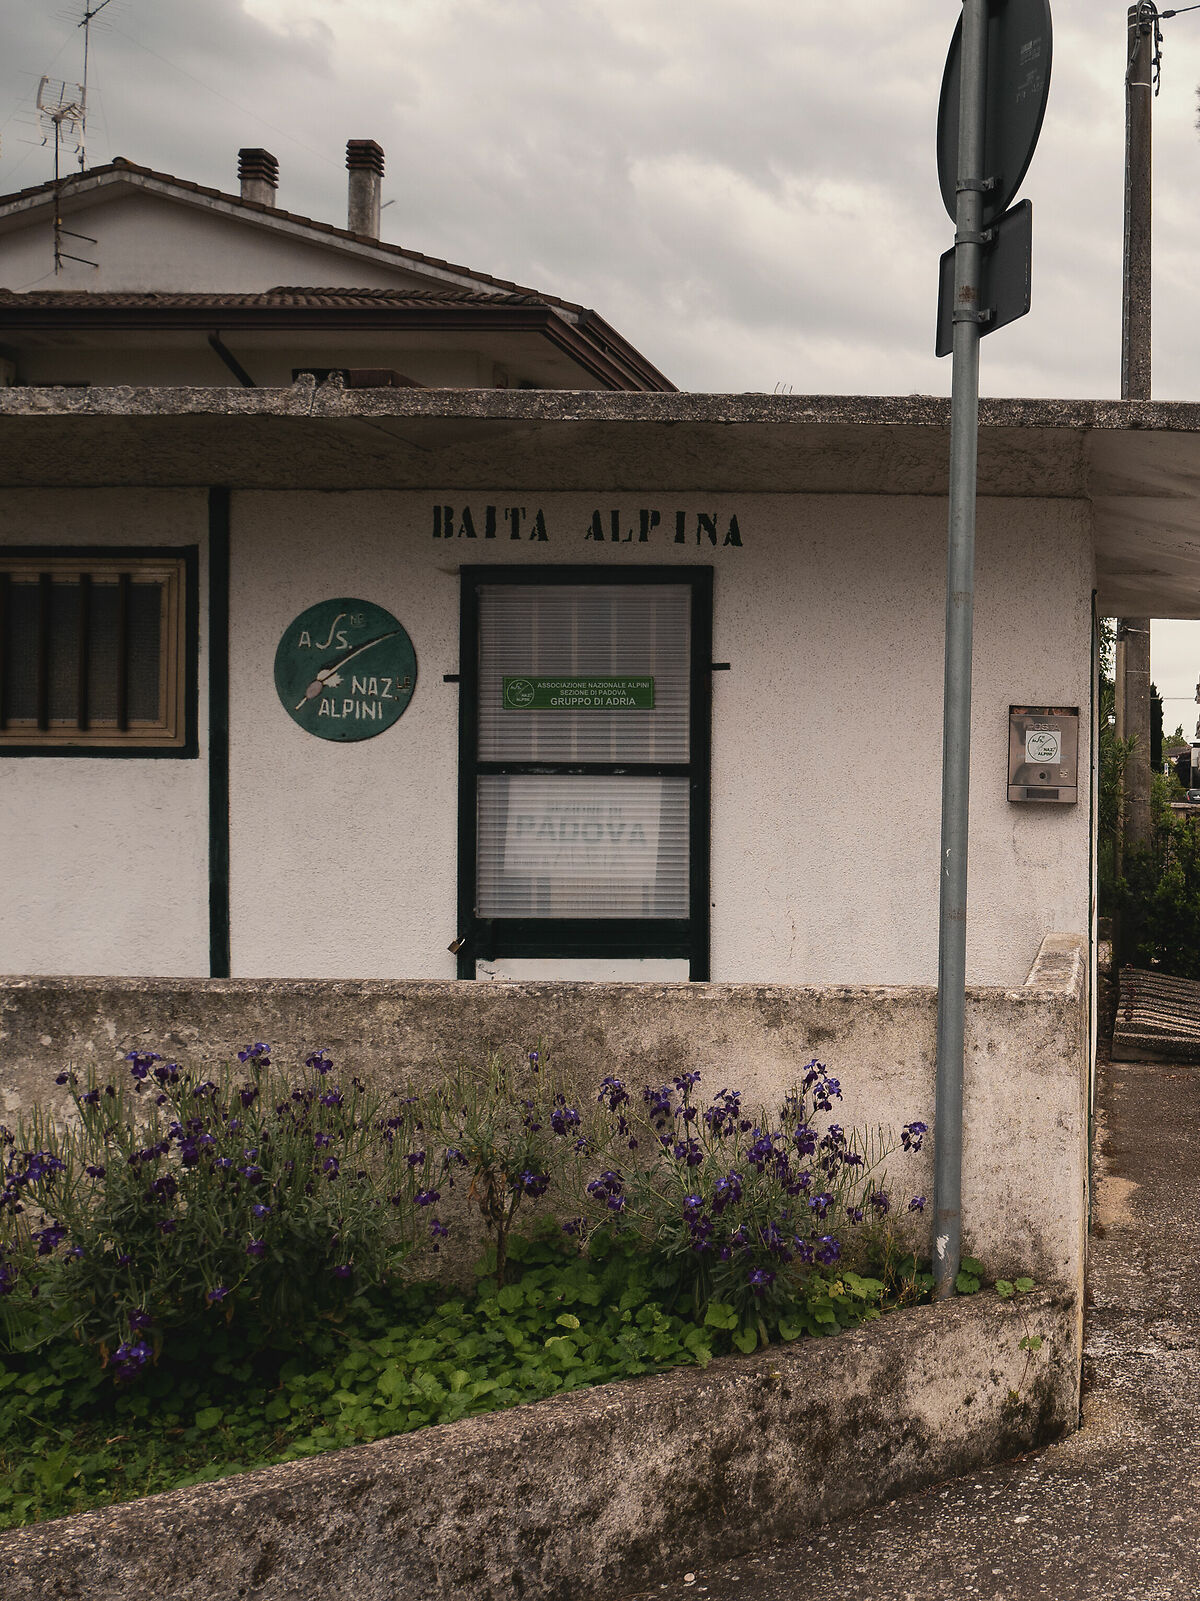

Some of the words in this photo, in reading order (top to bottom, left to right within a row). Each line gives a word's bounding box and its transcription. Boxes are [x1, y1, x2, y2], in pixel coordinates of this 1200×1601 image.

[433, 505, 549, 541] BAITA
[584, 509, 743, 547] ALPINA
[318, 699, 383, 720] ALPINI
[550, 697, 592, 706] GRUPPO
[593, 697, 604, 706] DI
[605, 697, 636, 706] ADRIA
[516, 815, 647, 843] PADOVA
